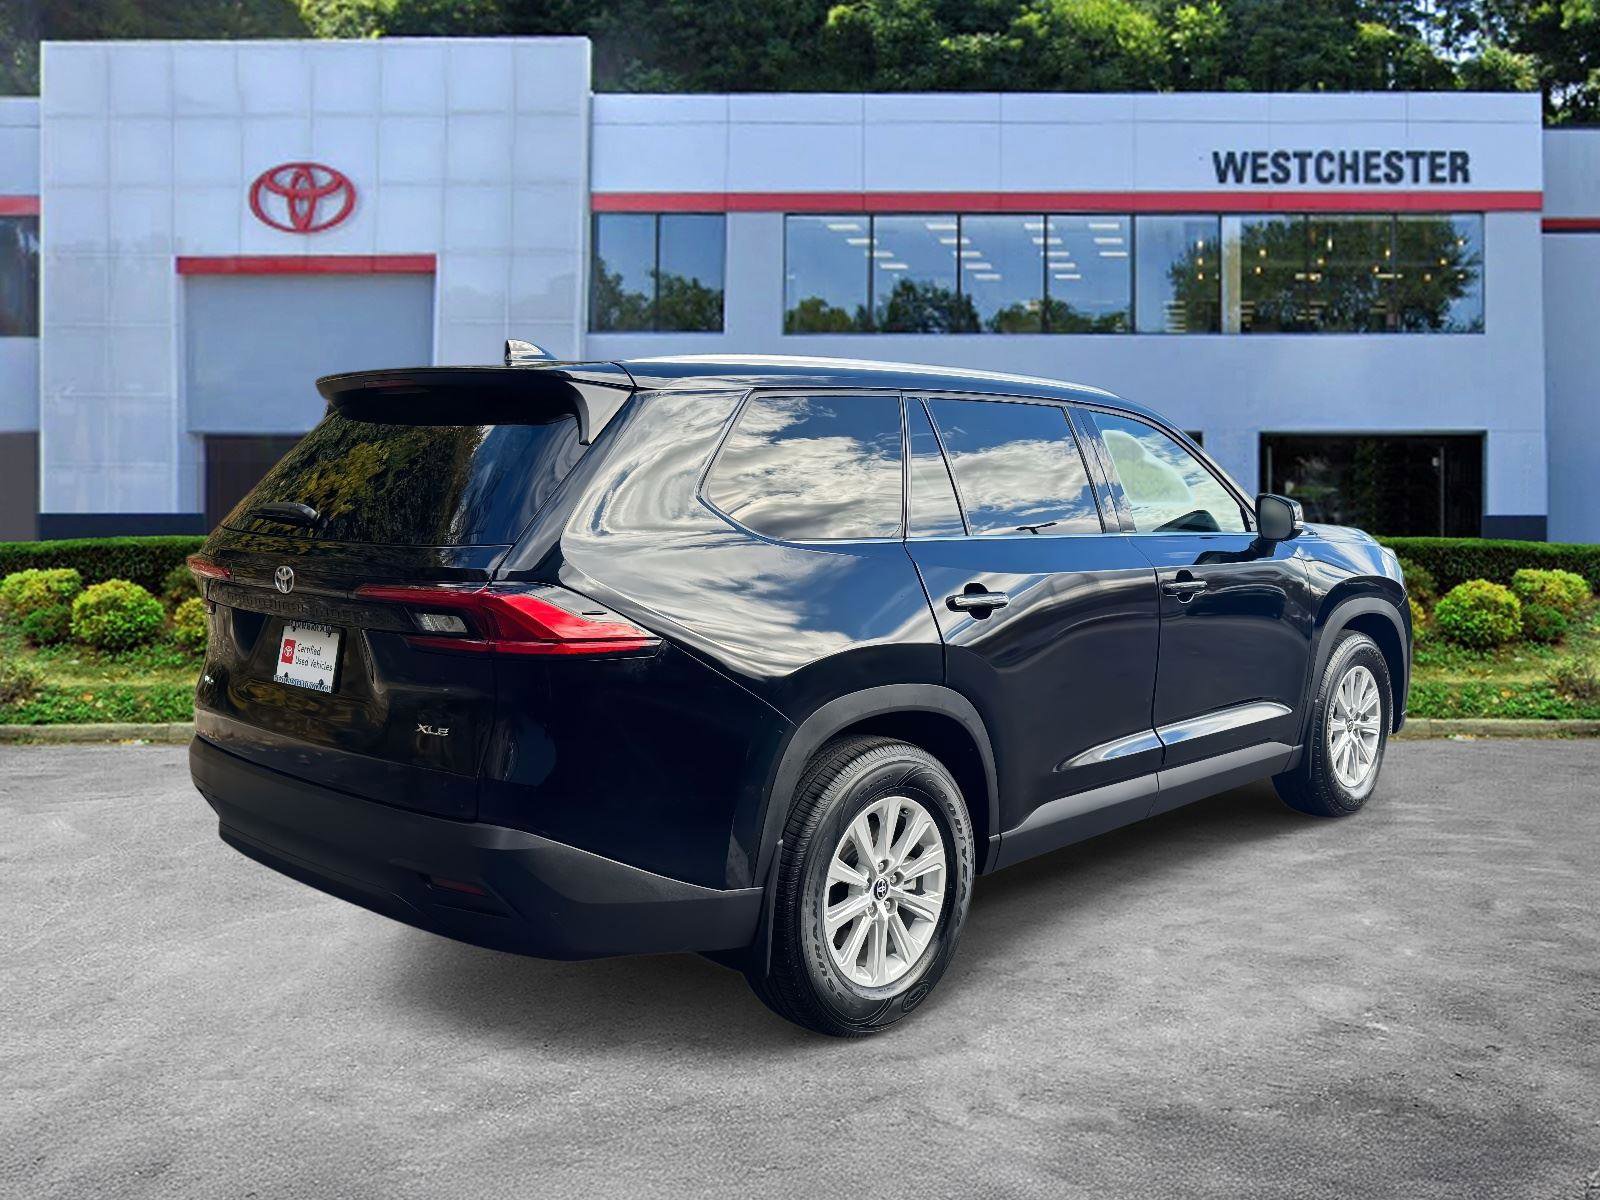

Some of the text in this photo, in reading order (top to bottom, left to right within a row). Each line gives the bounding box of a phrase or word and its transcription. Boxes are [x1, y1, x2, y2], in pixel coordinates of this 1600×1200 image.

[1212, 150, 1471, 184] WESTCHESTER
[297, 643, 321, 656] Certified
[295, 656, 333, 671] Used Vehicles
[415, 723, 449, 736] XLE
